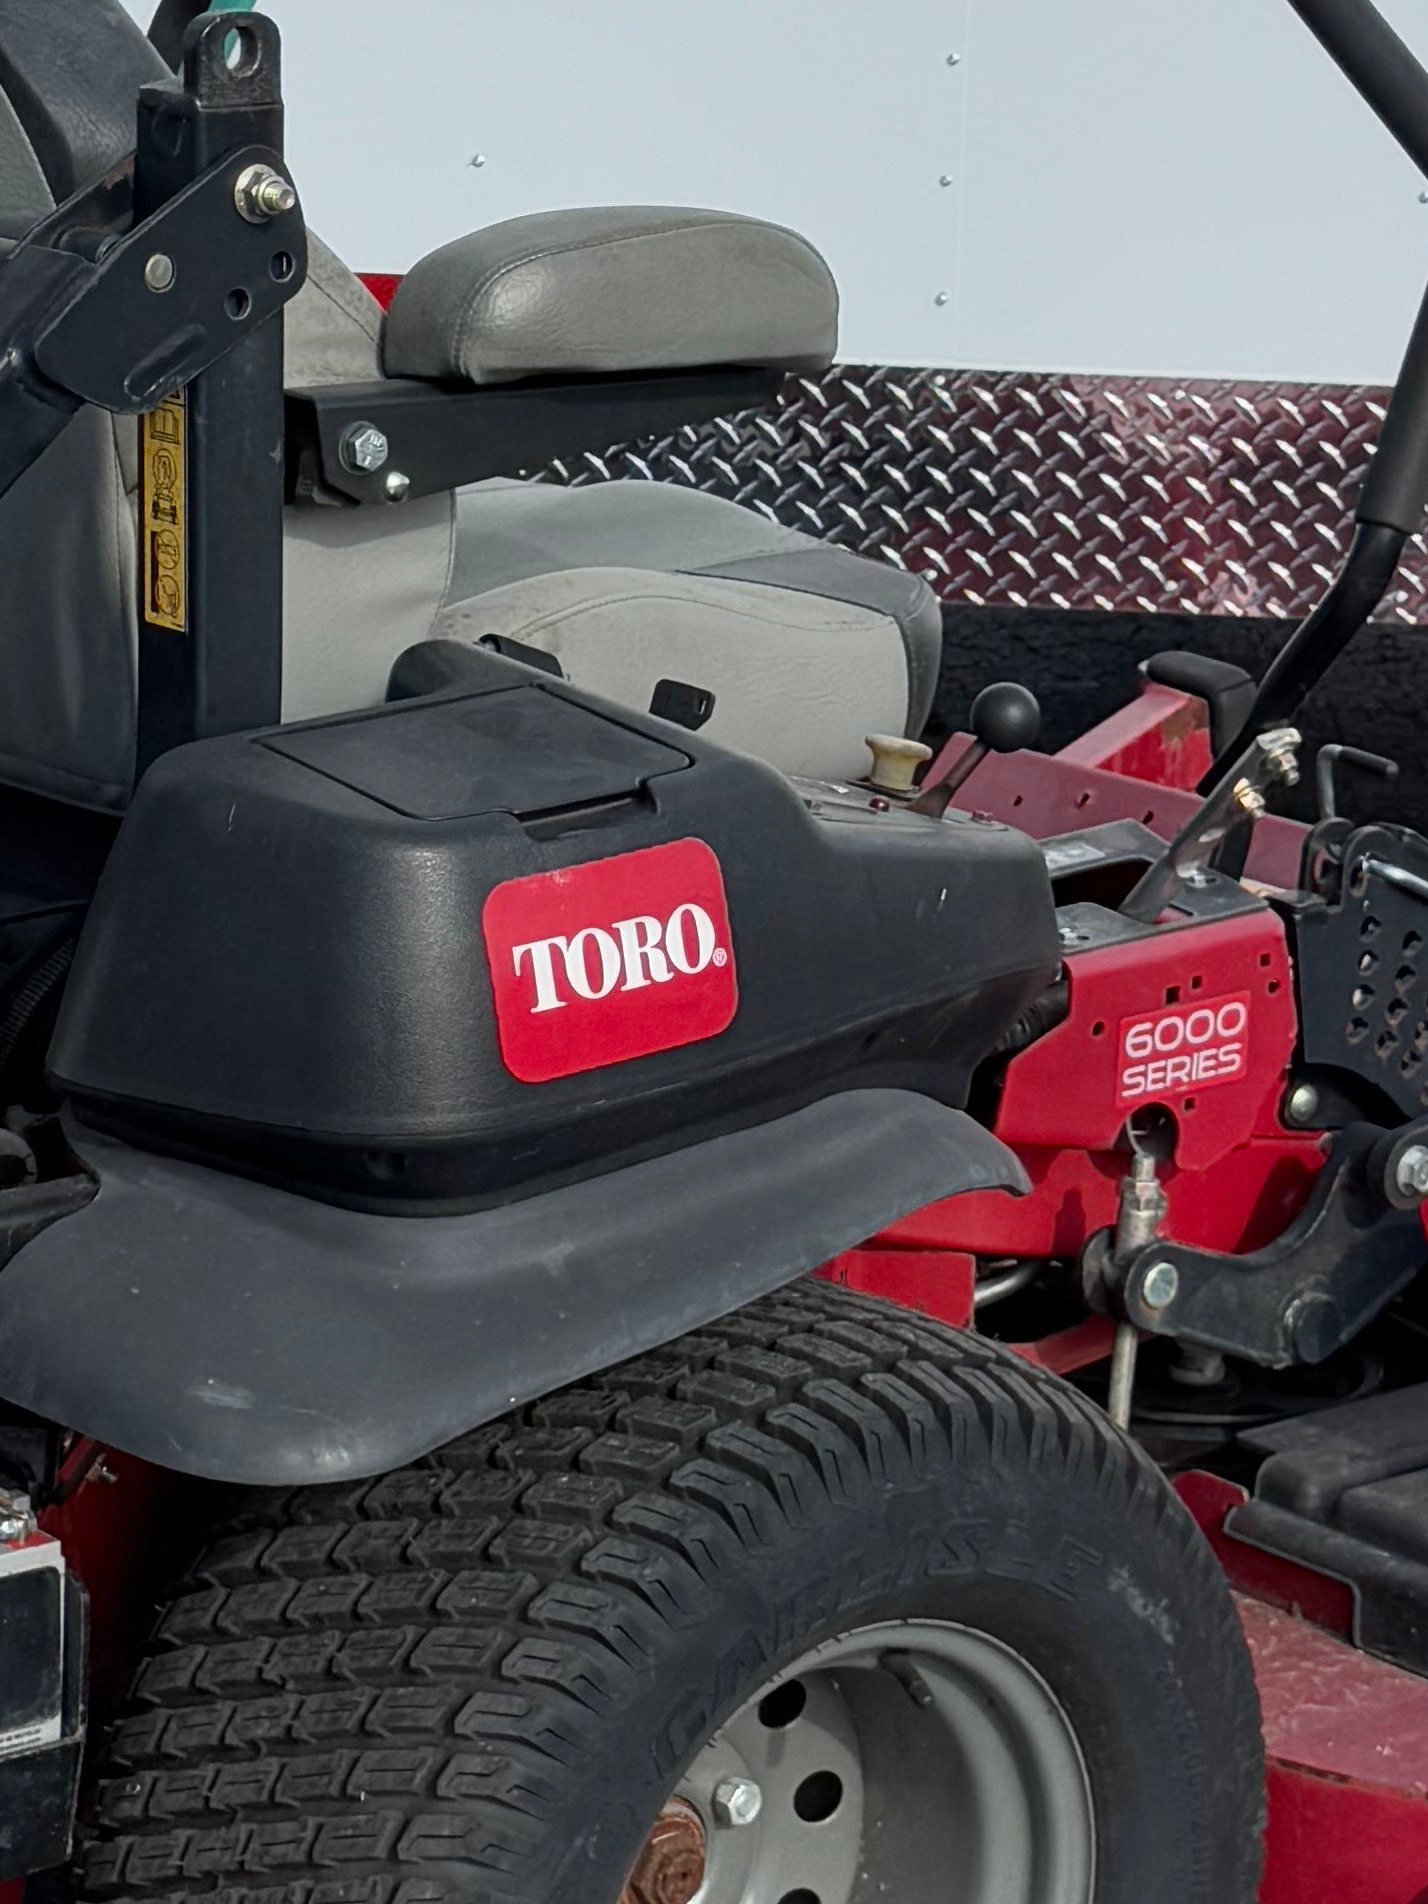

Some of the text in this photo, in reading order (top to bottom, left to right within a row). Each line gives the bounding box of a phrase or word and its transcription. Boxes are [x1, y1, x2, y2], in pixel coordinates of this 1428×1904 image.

[512, 904, 715, 1013] TORO
[1125, 1001, 1246, 1058] 6000
[1122, 1042, 1242, 1097] SERIES
